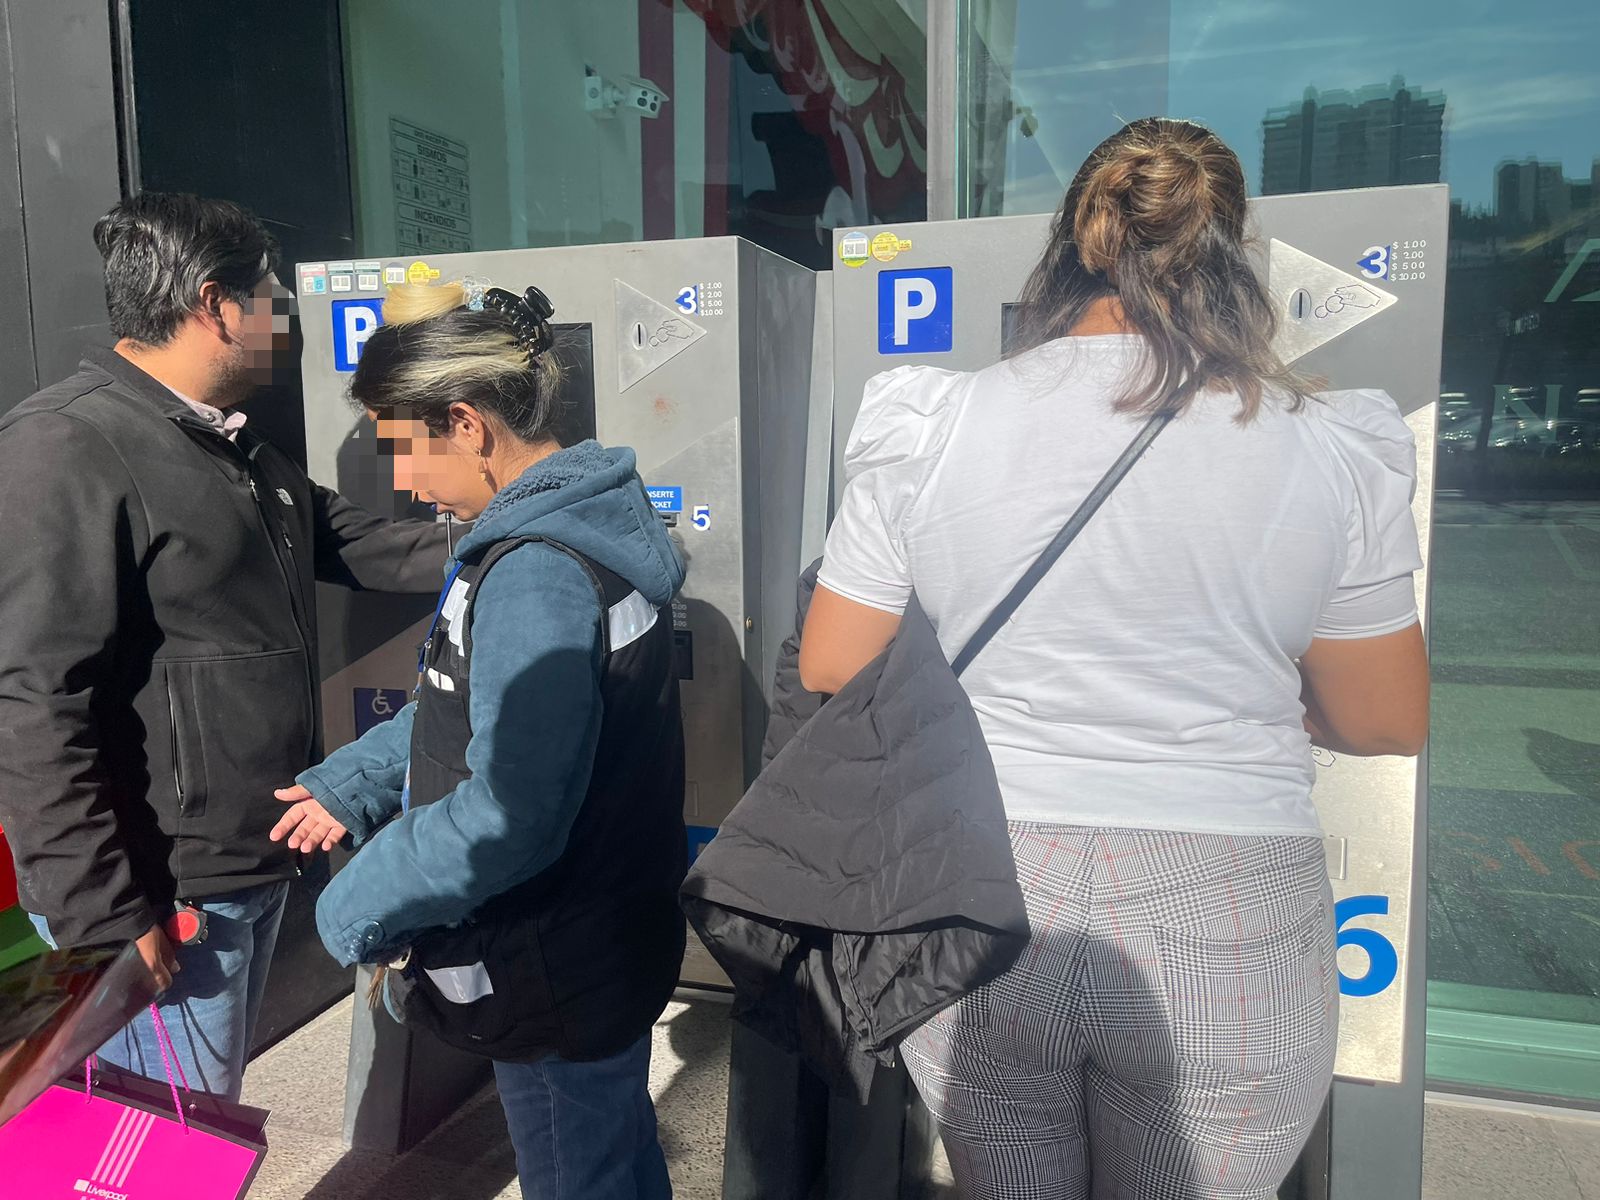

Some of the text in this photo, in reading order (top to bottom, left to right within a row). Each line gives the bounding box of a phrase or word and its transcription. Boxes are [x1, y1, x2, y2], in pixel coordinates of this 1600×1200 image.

[1361, 245, 1388, 279] 3
[678, 286, 697, 315] 3
[706, 281, 722, 290] 1.00
[894, 277, 937, 346] P
[344, 306, 378, 364] P
[646, 490, 674, 499] NSERTE
[692, 505, 711, 532] 5
[1334, 894, 1398, 998] 6
